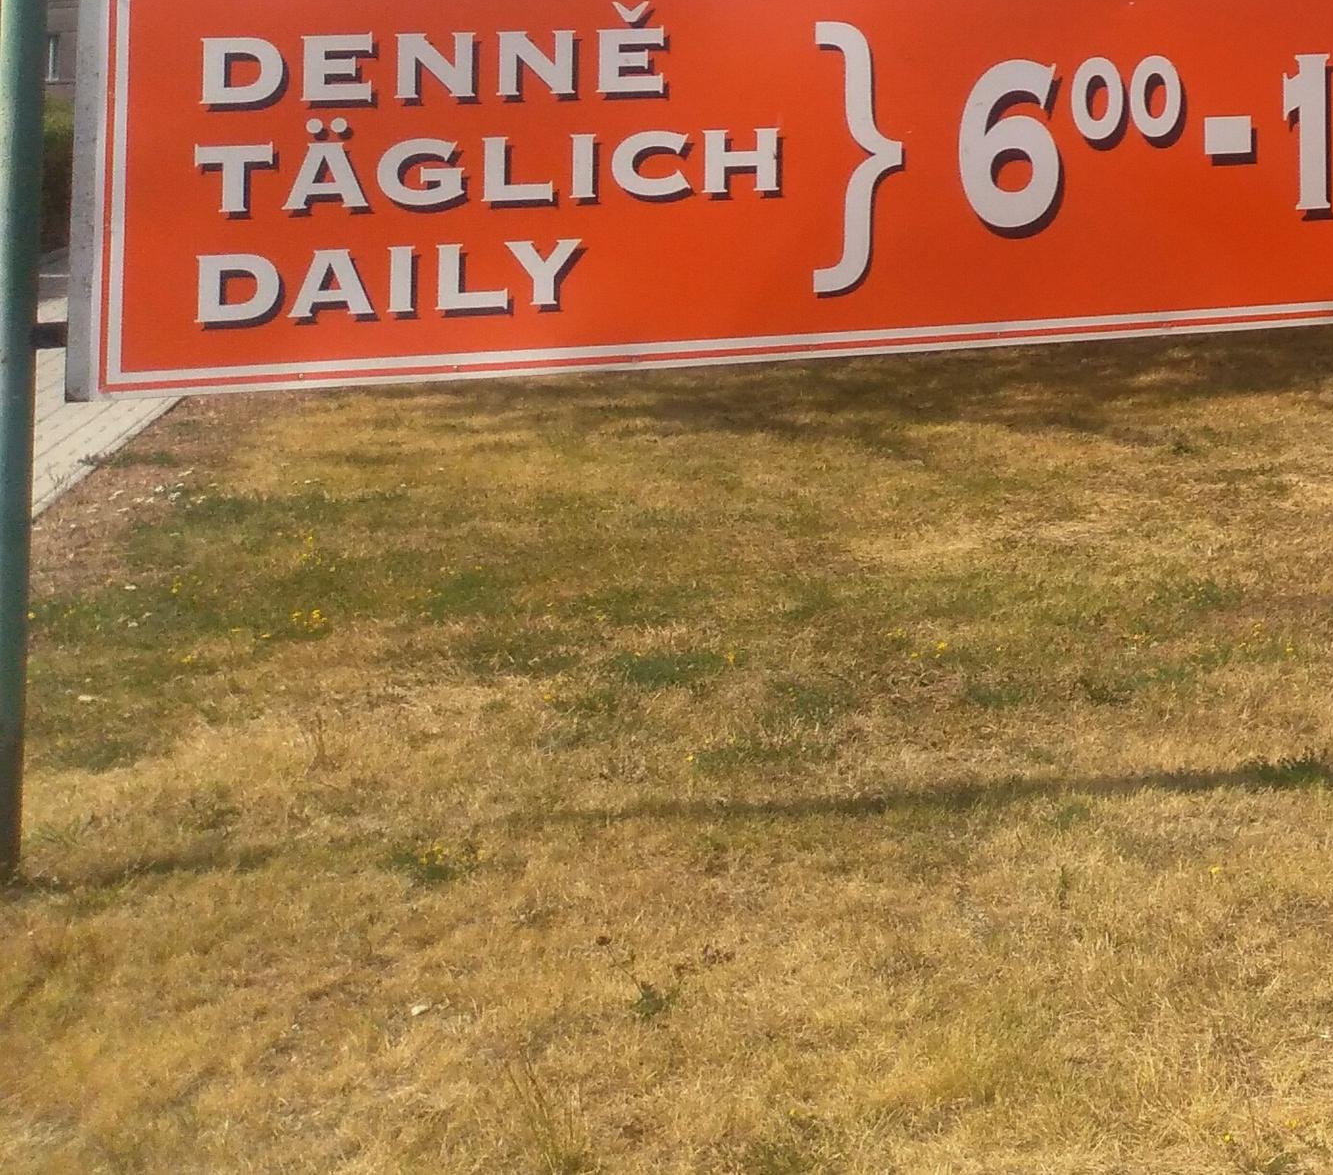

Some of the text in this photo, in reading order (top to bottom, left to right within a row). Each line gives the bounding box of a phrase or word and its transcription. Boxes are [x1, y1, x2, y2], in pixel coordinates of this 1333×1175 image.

[200, 0, 667, 109] DENNĚ
[195, 118, 783, 216] TÄGLICH
[195, 238, 585, 327] DAILY
